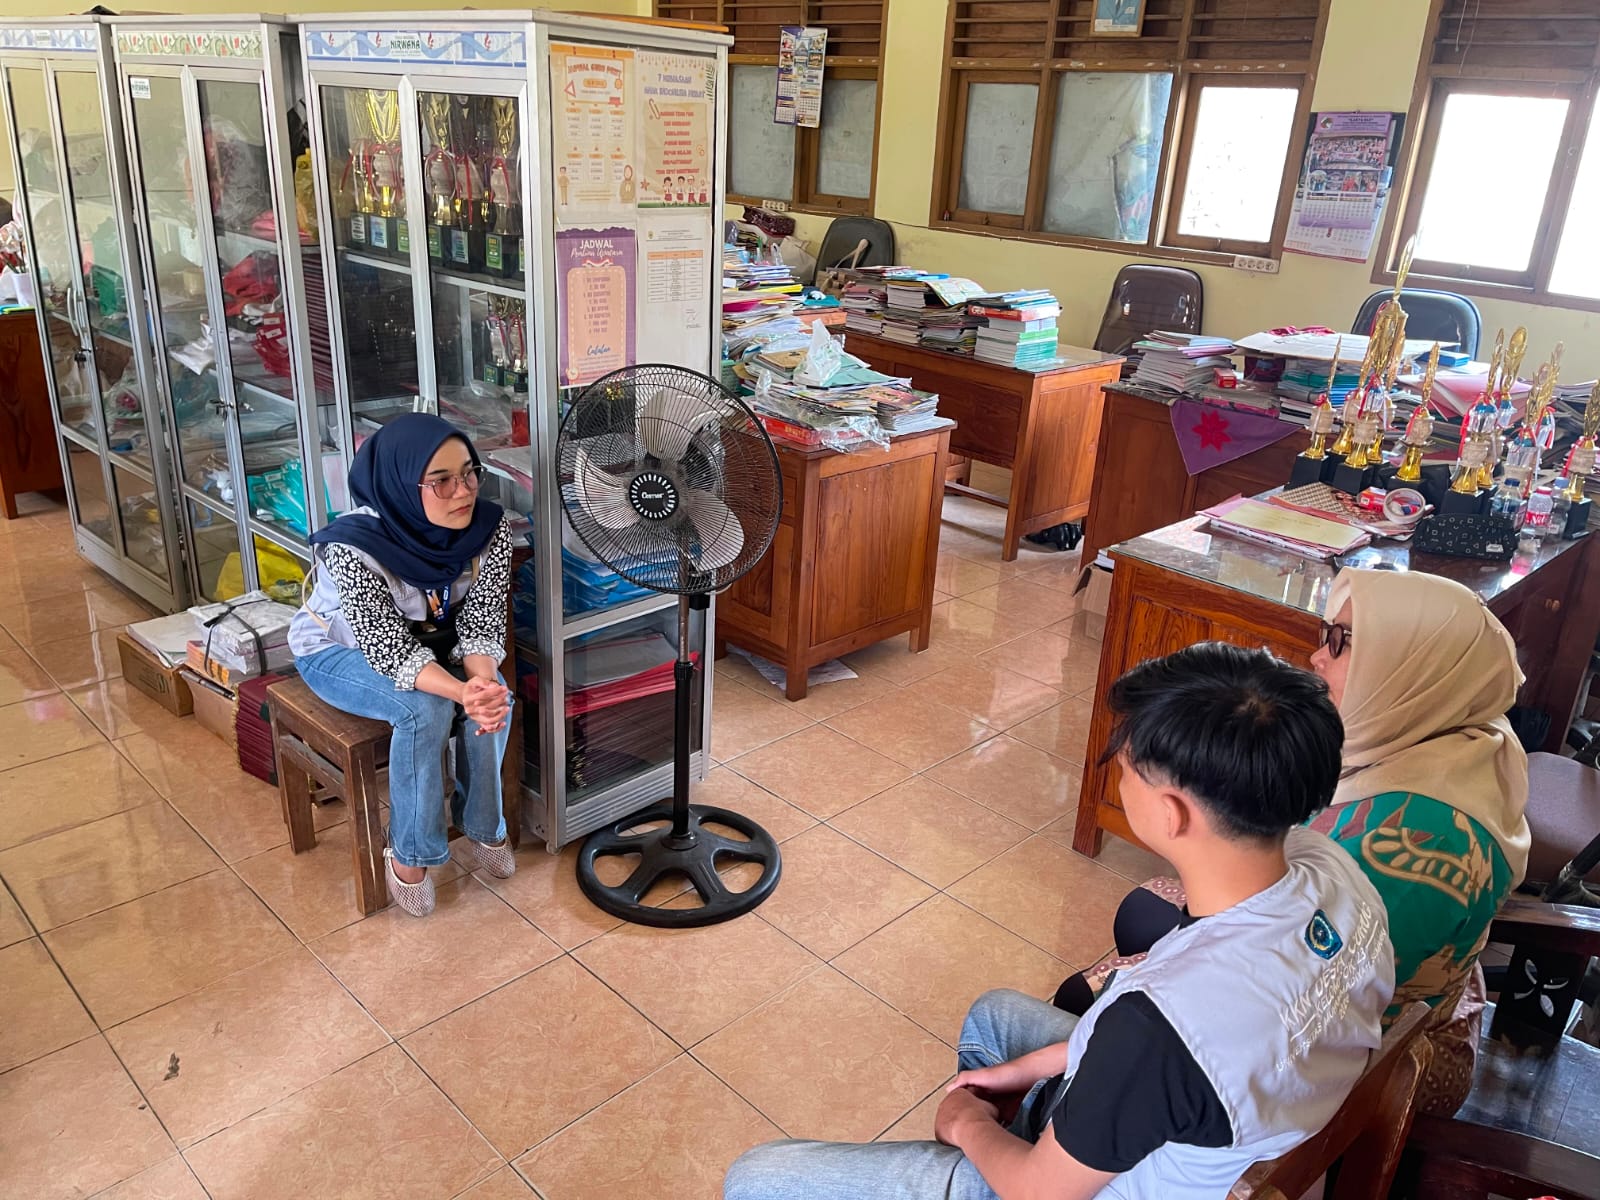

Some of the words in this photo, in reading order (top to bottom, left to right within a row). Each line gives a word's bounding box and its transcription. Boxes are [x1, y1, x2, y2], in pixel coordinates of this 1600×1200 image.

[390, 39, 420, 50] NIRWANA
[579, 239, 614, 249] JADWAL
[1278, 988, 1312, 1032] KKN
